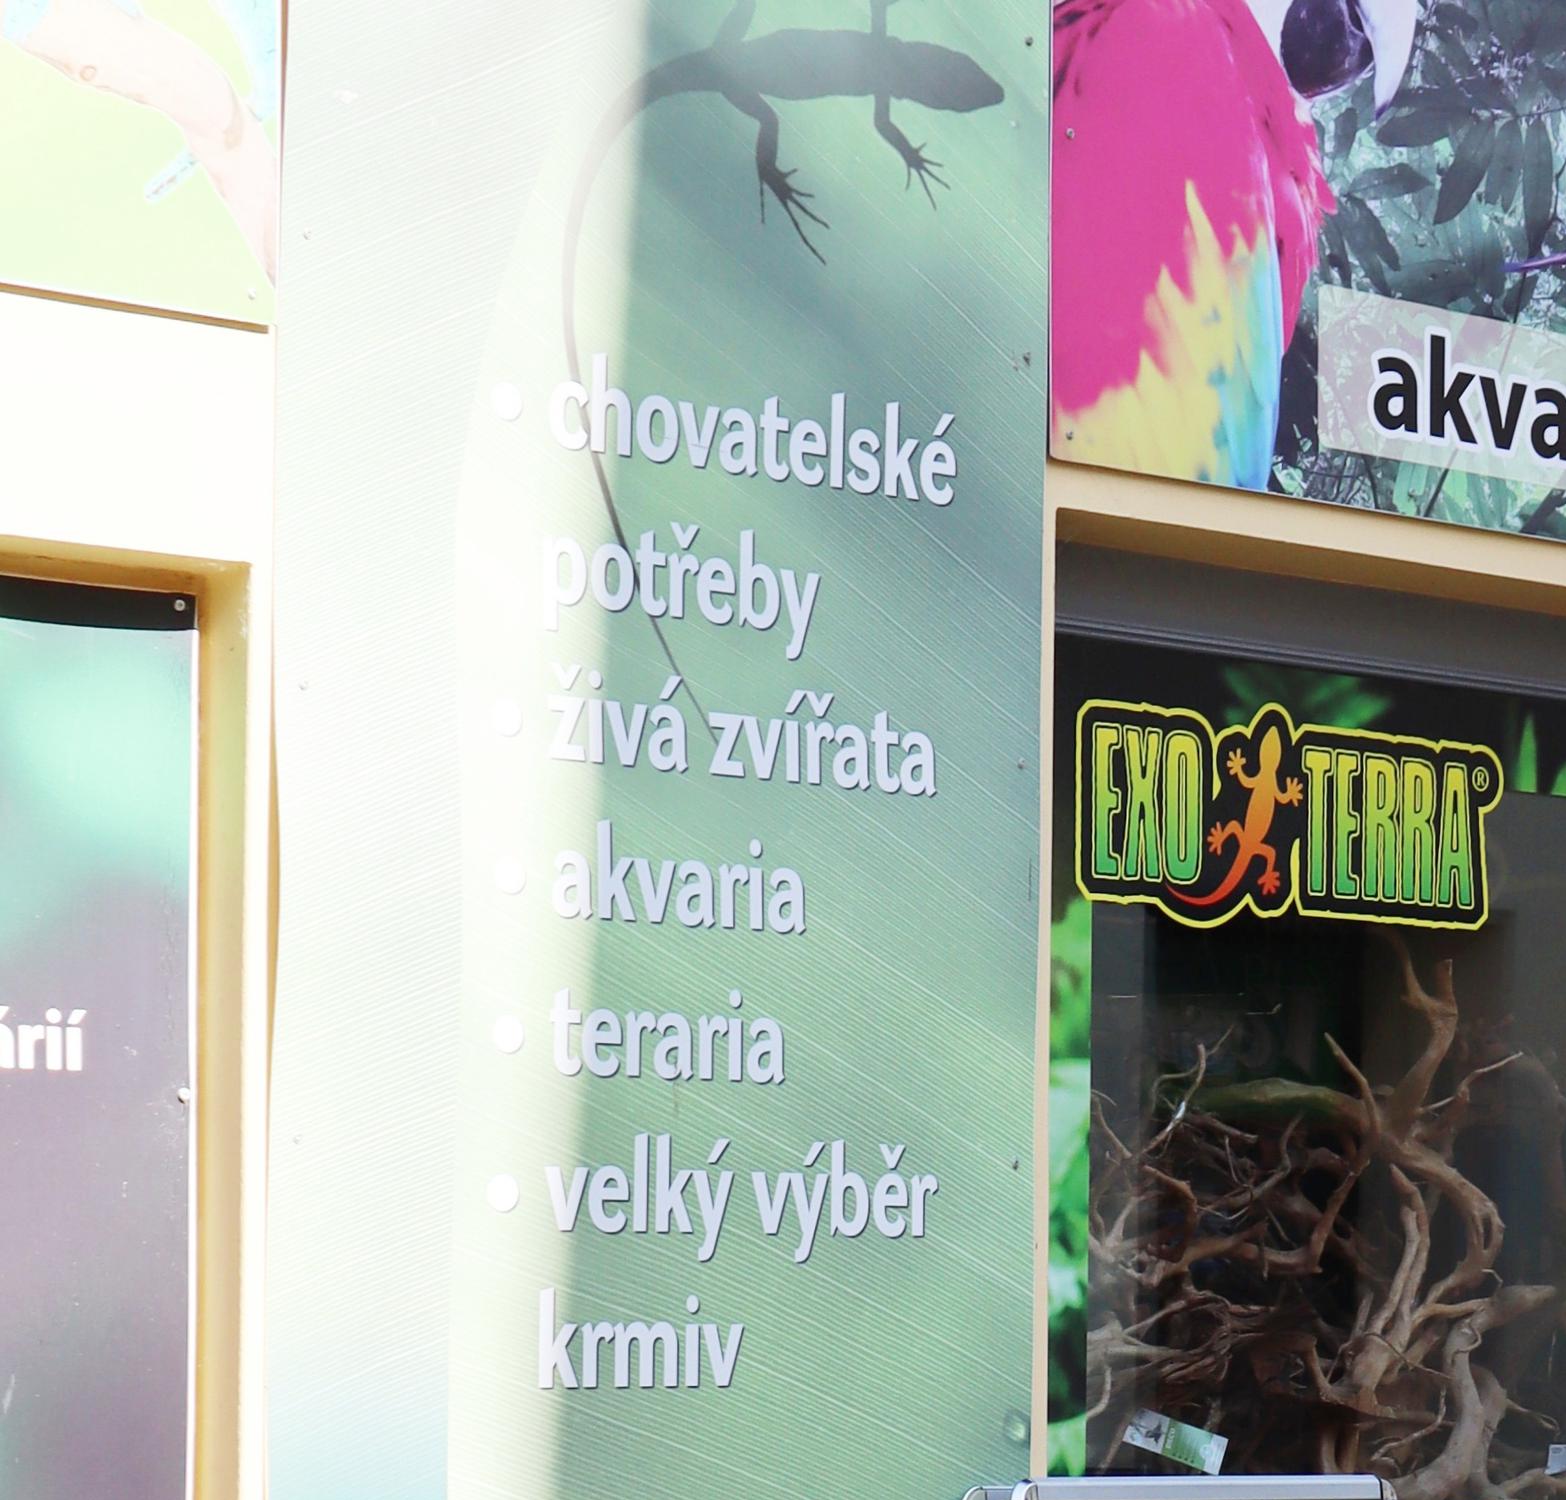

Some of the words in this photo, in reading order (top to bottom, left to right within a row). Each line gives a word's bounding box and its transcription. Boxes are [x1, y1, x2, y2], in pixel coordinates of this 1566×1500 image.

[548, 352, 958, 507] chovatelské
[543, 521, 820, 660] potřeby
[547, 662, 688, 774] živá
[708, 690, 937, 798] zvířata
[551, 818, 806, 934] akvaria
[1092, 722, 1203, 885] EXO
[1302, 746, 1475, 909] TERRA
[550, 987, 785, 1084] teraria
[545, 1132, 735, 1262] velký
[752, 1139, 940, 1263] výběr
[538, 1286, 744, 1389] krmiv
